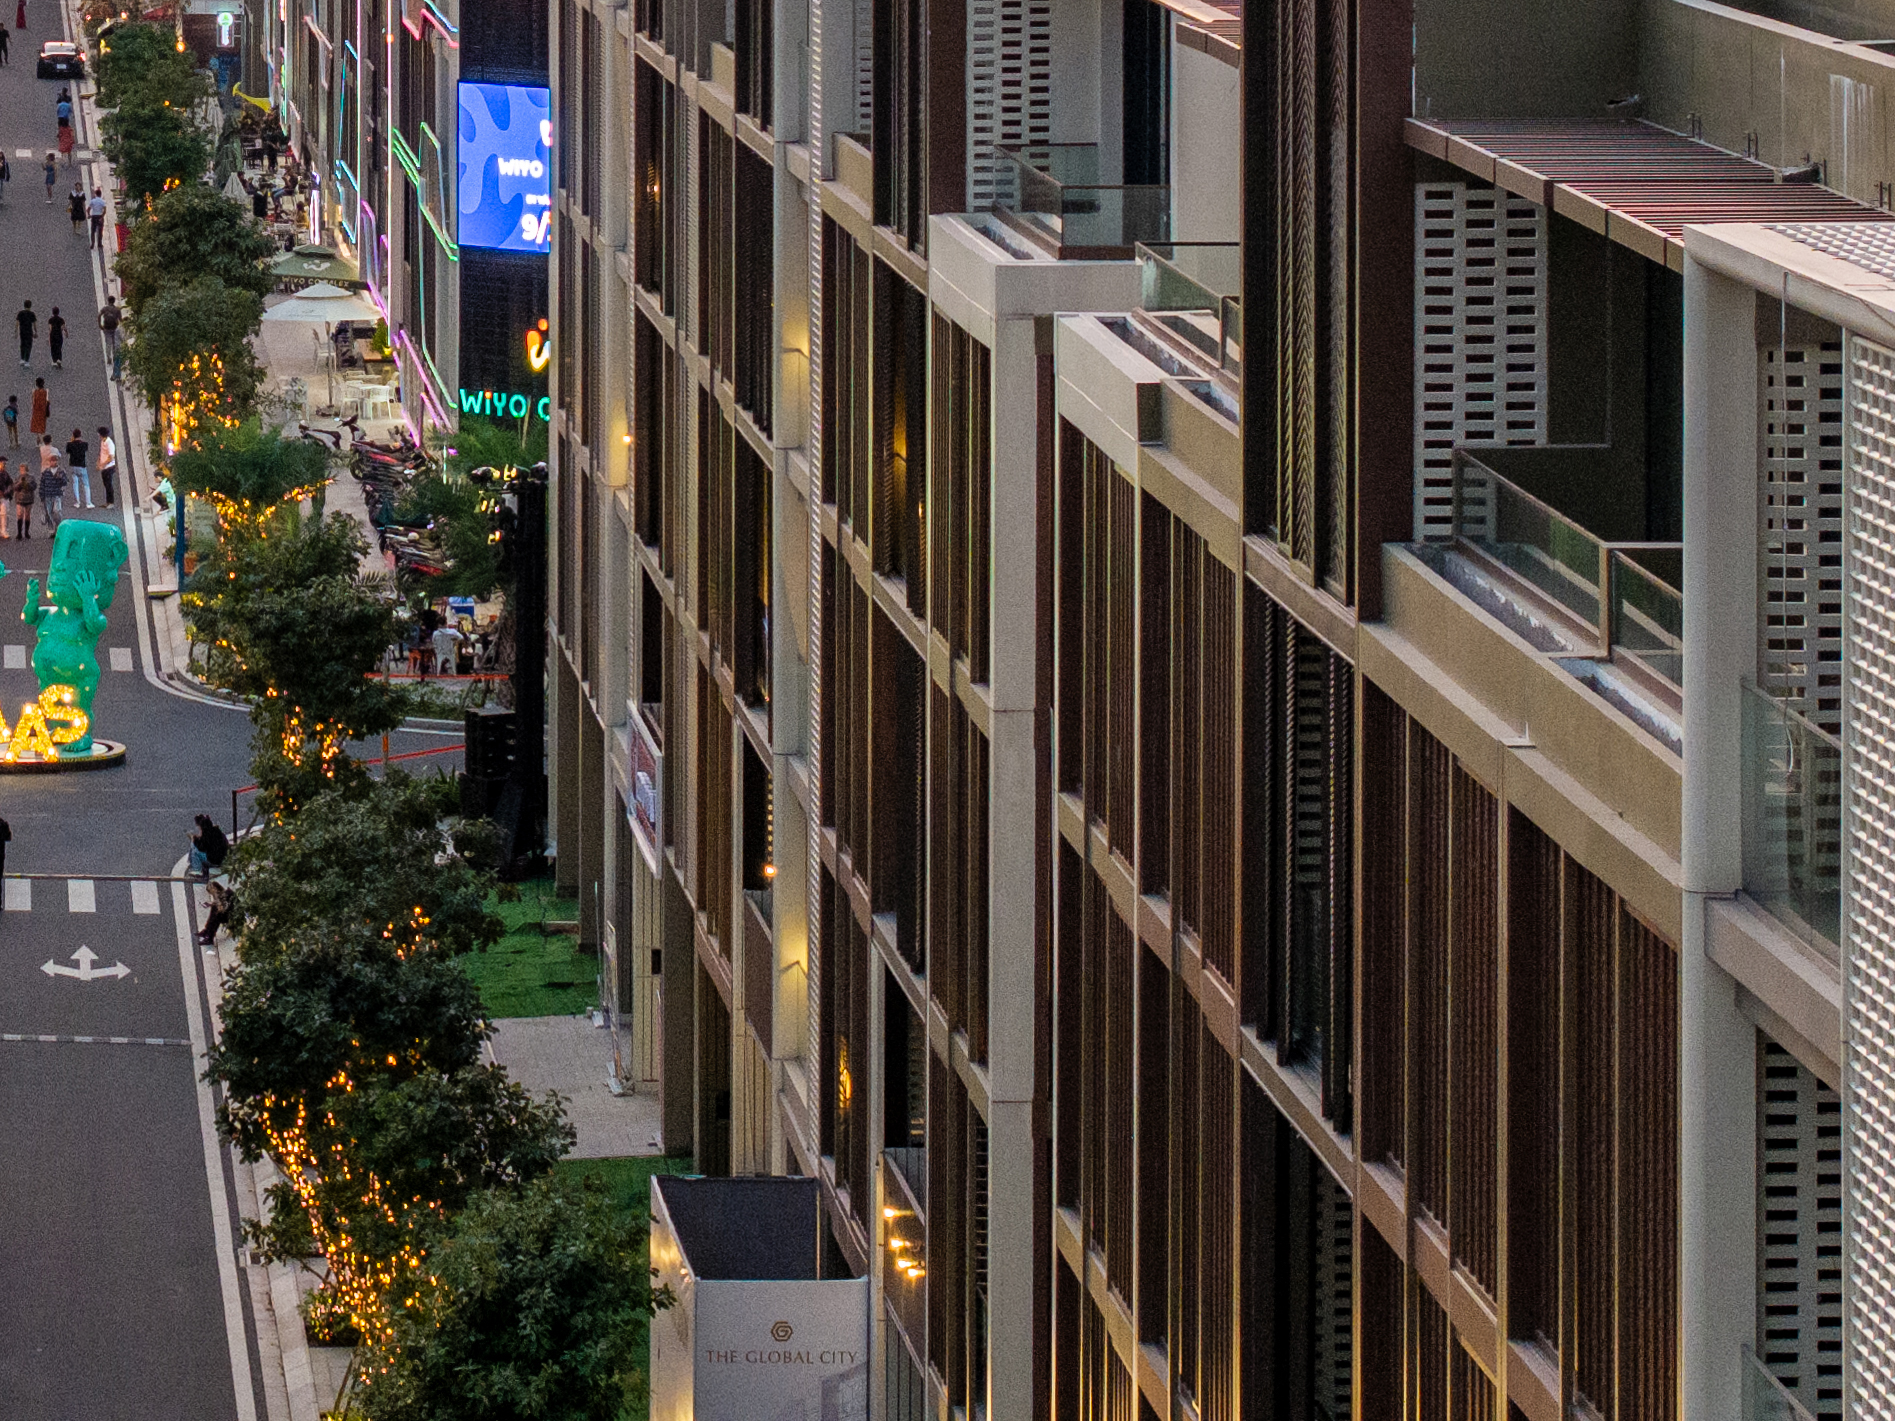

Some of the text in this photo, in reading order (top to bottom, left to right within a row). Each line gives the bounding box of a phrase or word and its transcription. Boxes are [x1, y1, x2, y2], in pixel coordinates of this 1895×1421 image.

[497, 158, 543, 178] WIYO
[521, 211, 551, 244] 9/
[706, 1350, 859, 1364] THE GLOBAL CITY
